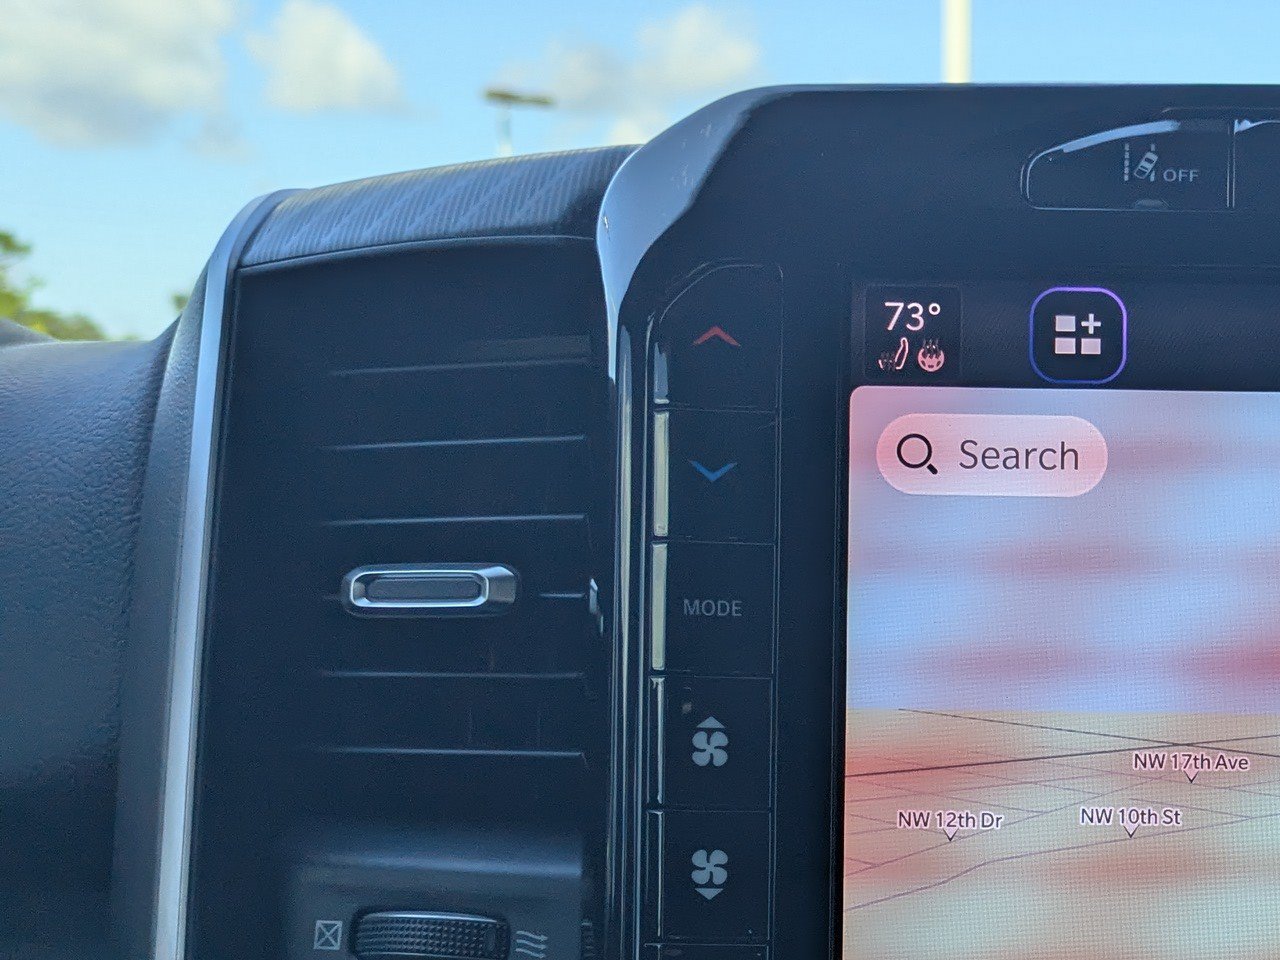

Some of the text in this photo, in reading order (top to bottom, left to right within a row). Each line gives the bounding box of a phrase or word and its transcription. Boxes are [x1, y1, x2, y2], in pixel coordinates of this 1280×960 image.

[1164, 169, 1199, 183] OFF
[884, 301, 941, 331] 73°
[959, 440, 1079, 471] Search
[683, 599, 743, 617] MODE
[1134, 753, 1249, 770] NW 17th Ave
[899, 811, 1002, 828] NW 12th Dr
[1081, 808, 1180, 825] NW 10th St
